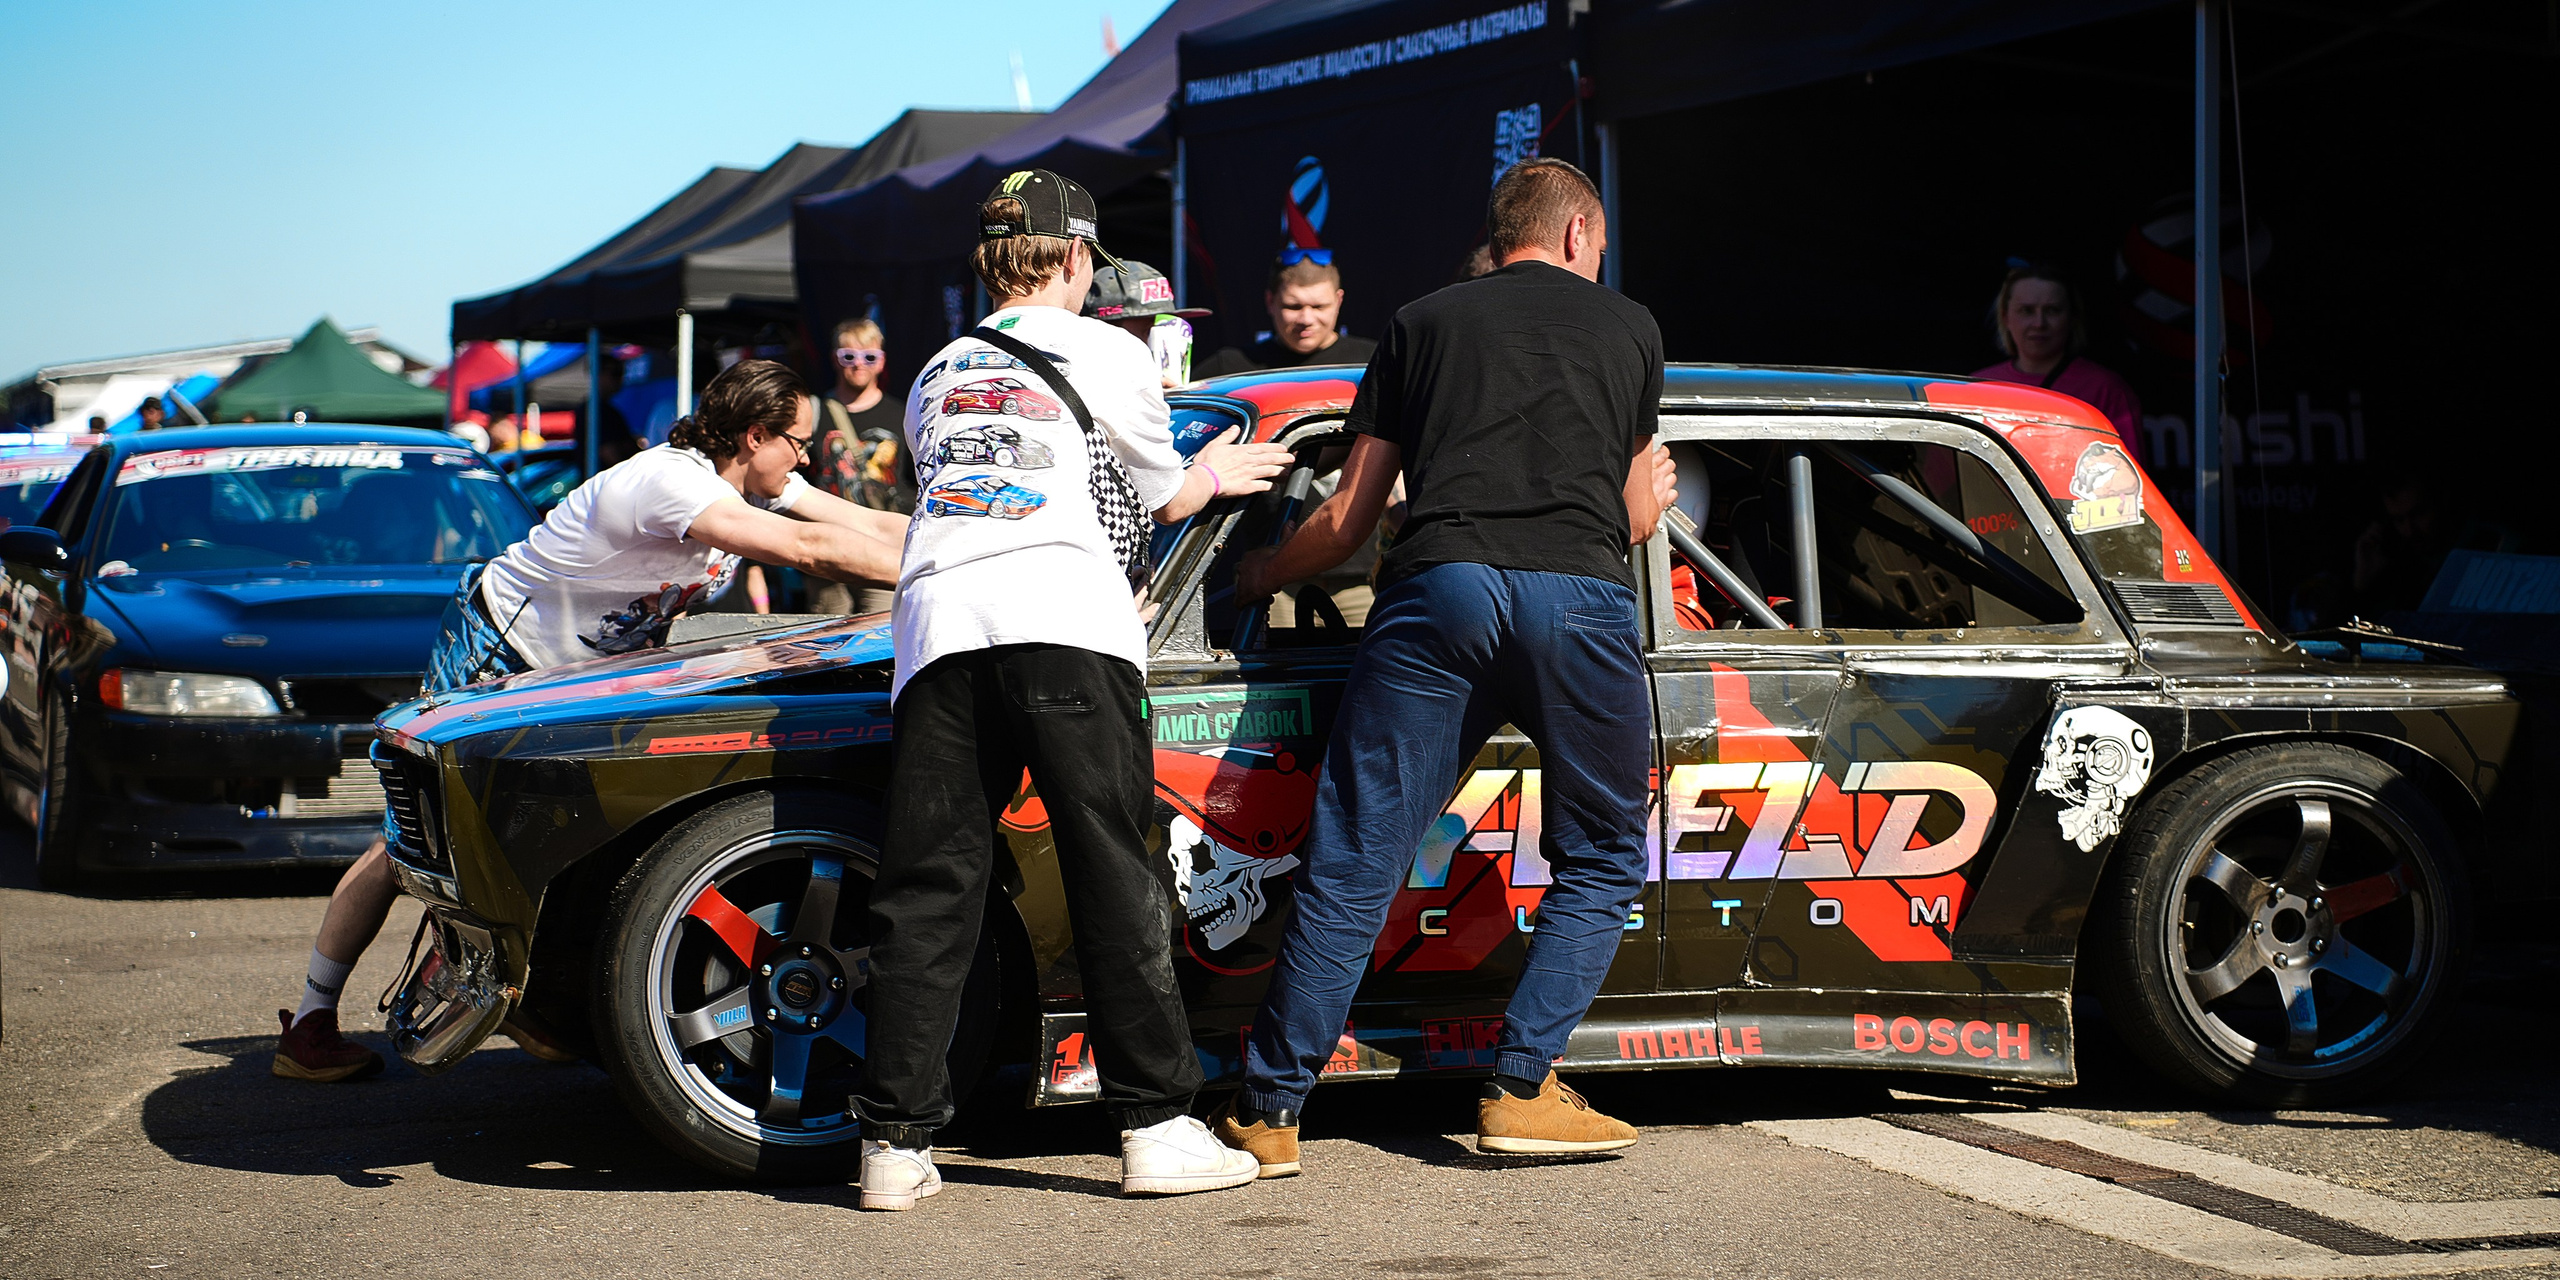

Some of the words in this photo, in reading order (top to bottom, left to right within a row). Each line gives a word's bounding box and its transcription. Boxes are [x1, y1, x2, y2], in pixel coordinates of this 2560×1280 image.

[1967, 512, 2018, 535] 100%
[1157, 713, 1212, 742] ЛИГА
[1214, 710, 1299, 741] СТАВОК
[1617, 1025, 1763, 1060] MAHLE
[1853, 1013, 2031, 1060] BOSCH
